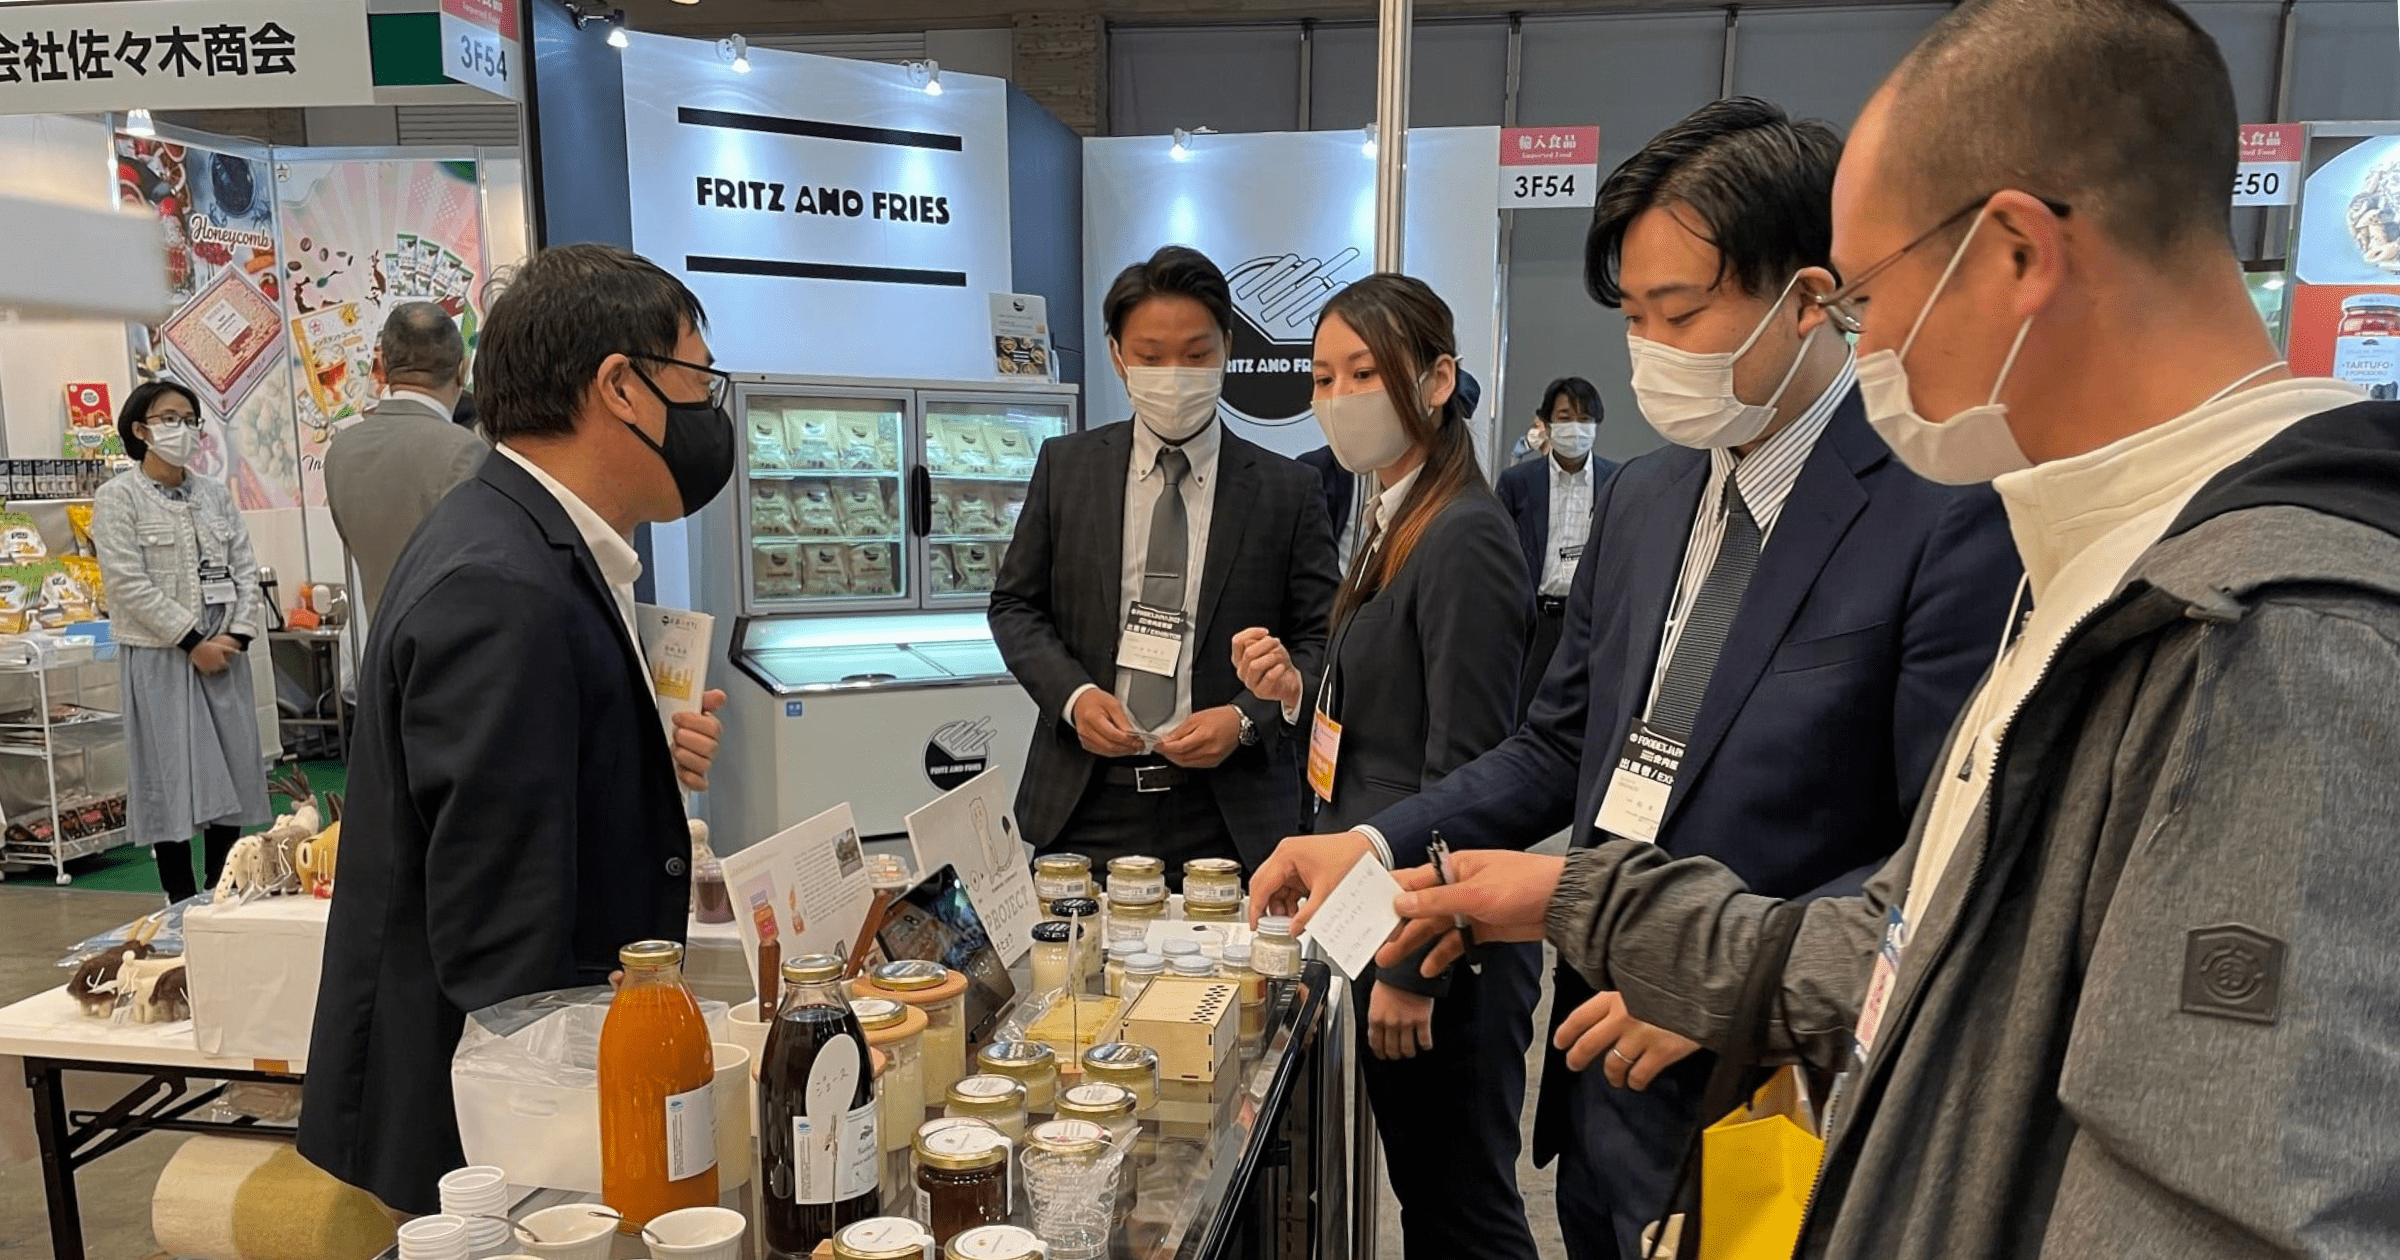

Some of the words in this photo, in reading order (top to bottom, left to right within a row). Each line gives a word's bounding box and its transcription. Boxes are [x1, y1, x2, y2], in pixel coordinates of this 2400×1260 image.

[460, 34, 507, 82] 3F54
[696, 176, 785, 213] FRITZ
[795, 185, 864, 218] AND
[873, 193, 951, 226] FRIES
[1514, 174, 1575, 198] 3F54
[191, 215, 270, 251] Honeycomb
[1256, 358, 1291, 373] AND
[984, 885, 1030, 934] PROJECT
